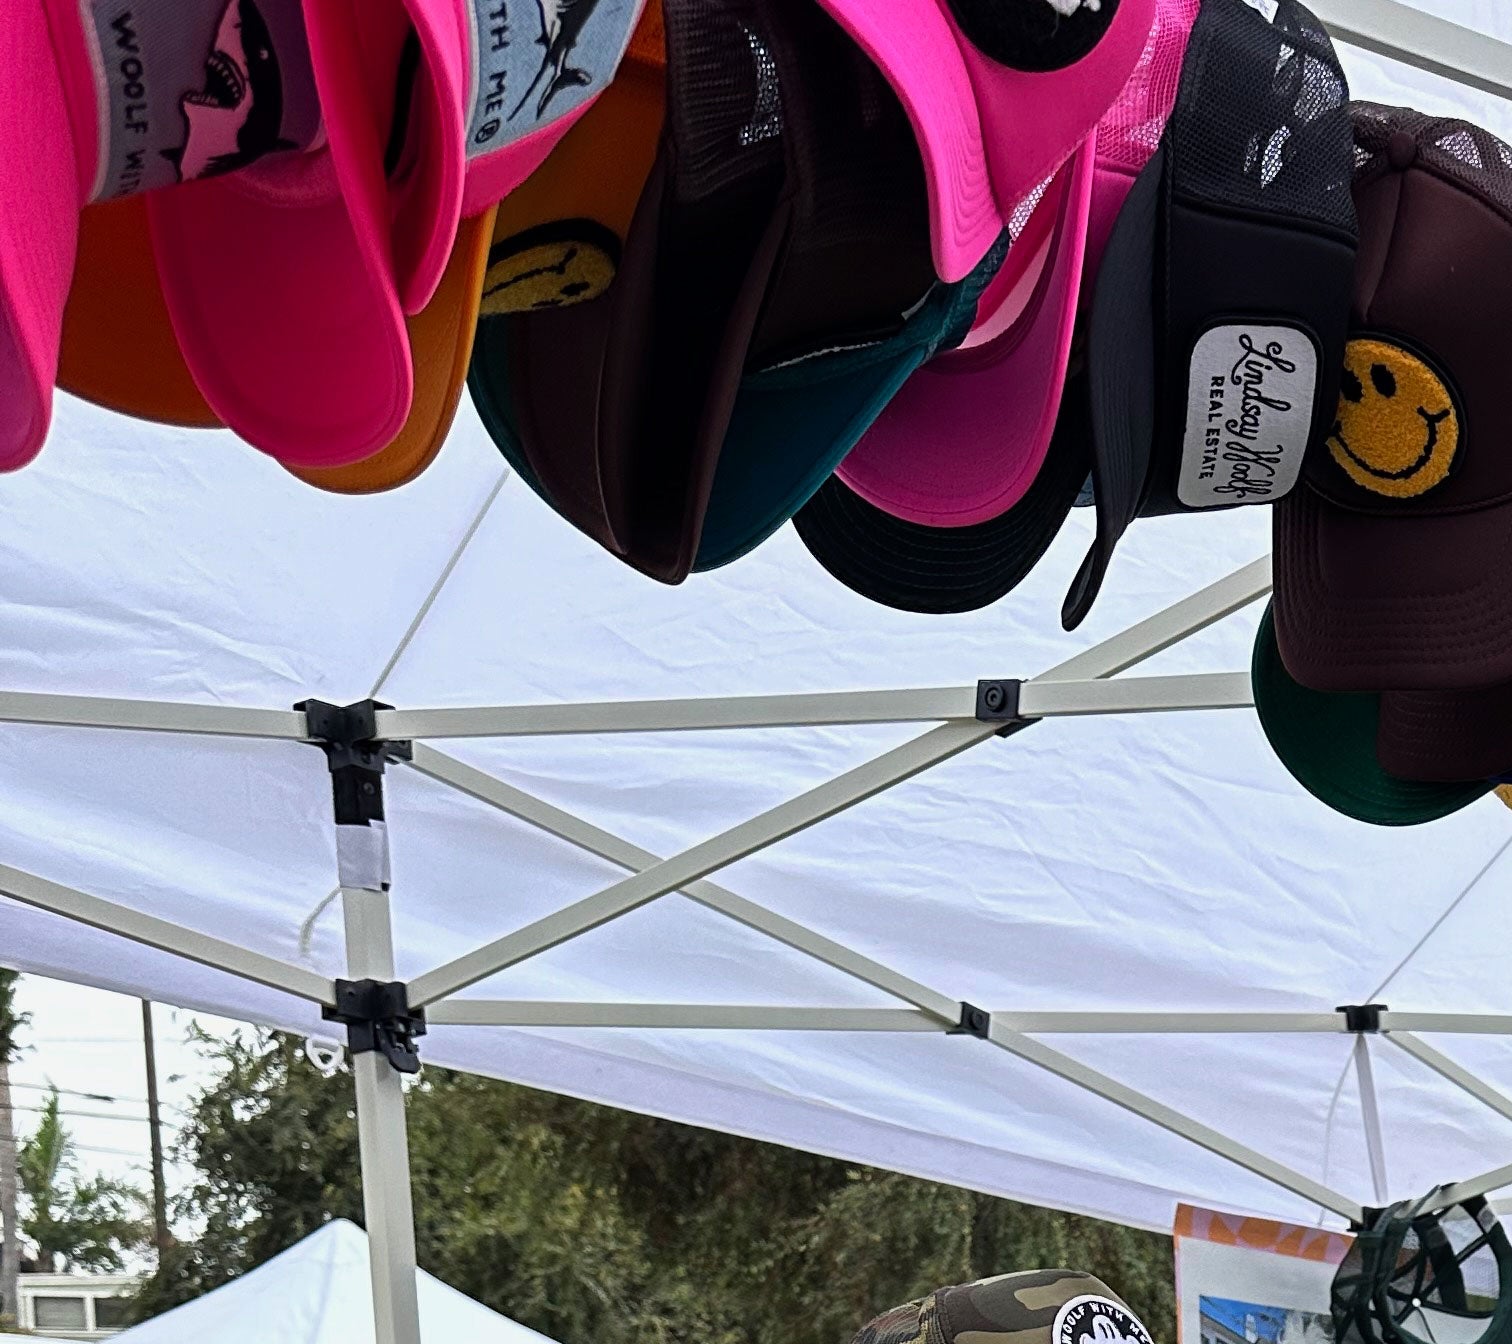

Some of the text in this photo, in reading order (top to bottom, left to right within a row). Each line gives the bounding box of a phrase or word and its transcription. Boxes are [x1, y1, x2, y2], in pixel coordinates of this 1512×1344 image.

[111, 10, 149, 136] WOOLF
[1198, 375, 1226, 480] REAL ESTATE
[1225, 333, 1296, 441] Lindsay
[1061, 1304, 1086, 1344] WOOLF
[1088, 1302, 1125, 1323] WITH
